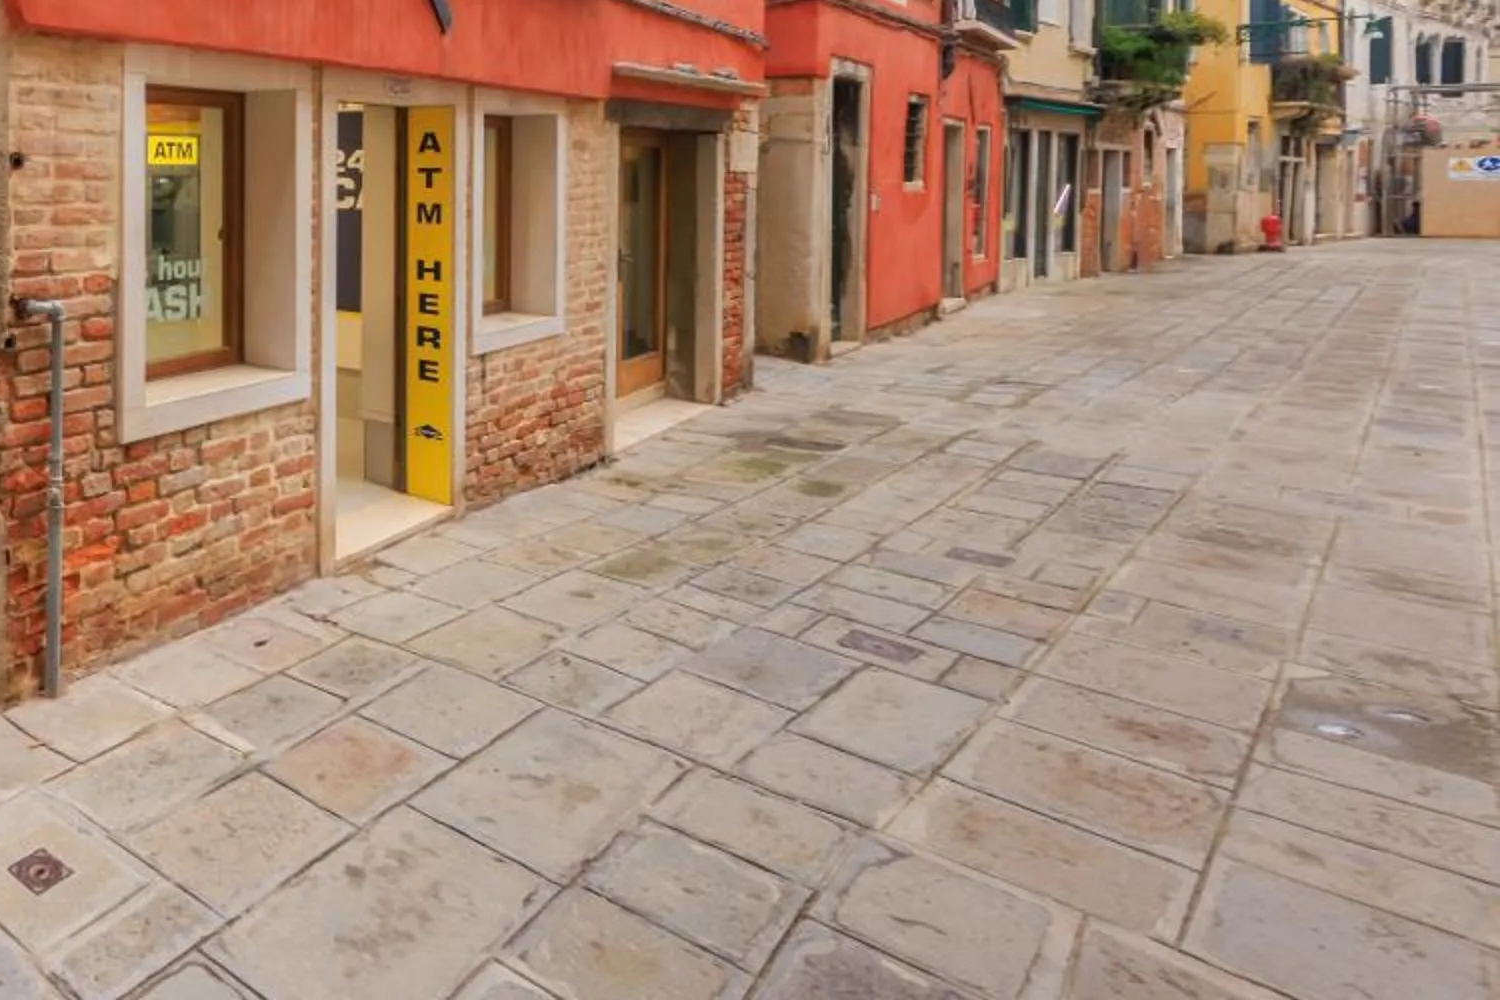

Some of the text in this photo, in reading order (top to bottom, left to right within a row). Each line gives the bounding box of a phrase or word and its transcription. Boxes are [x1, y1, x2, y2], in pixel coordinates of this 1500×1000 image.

[154, 142, 193, 160] ATM
[416, 131, 442, 383] ATM HERE
